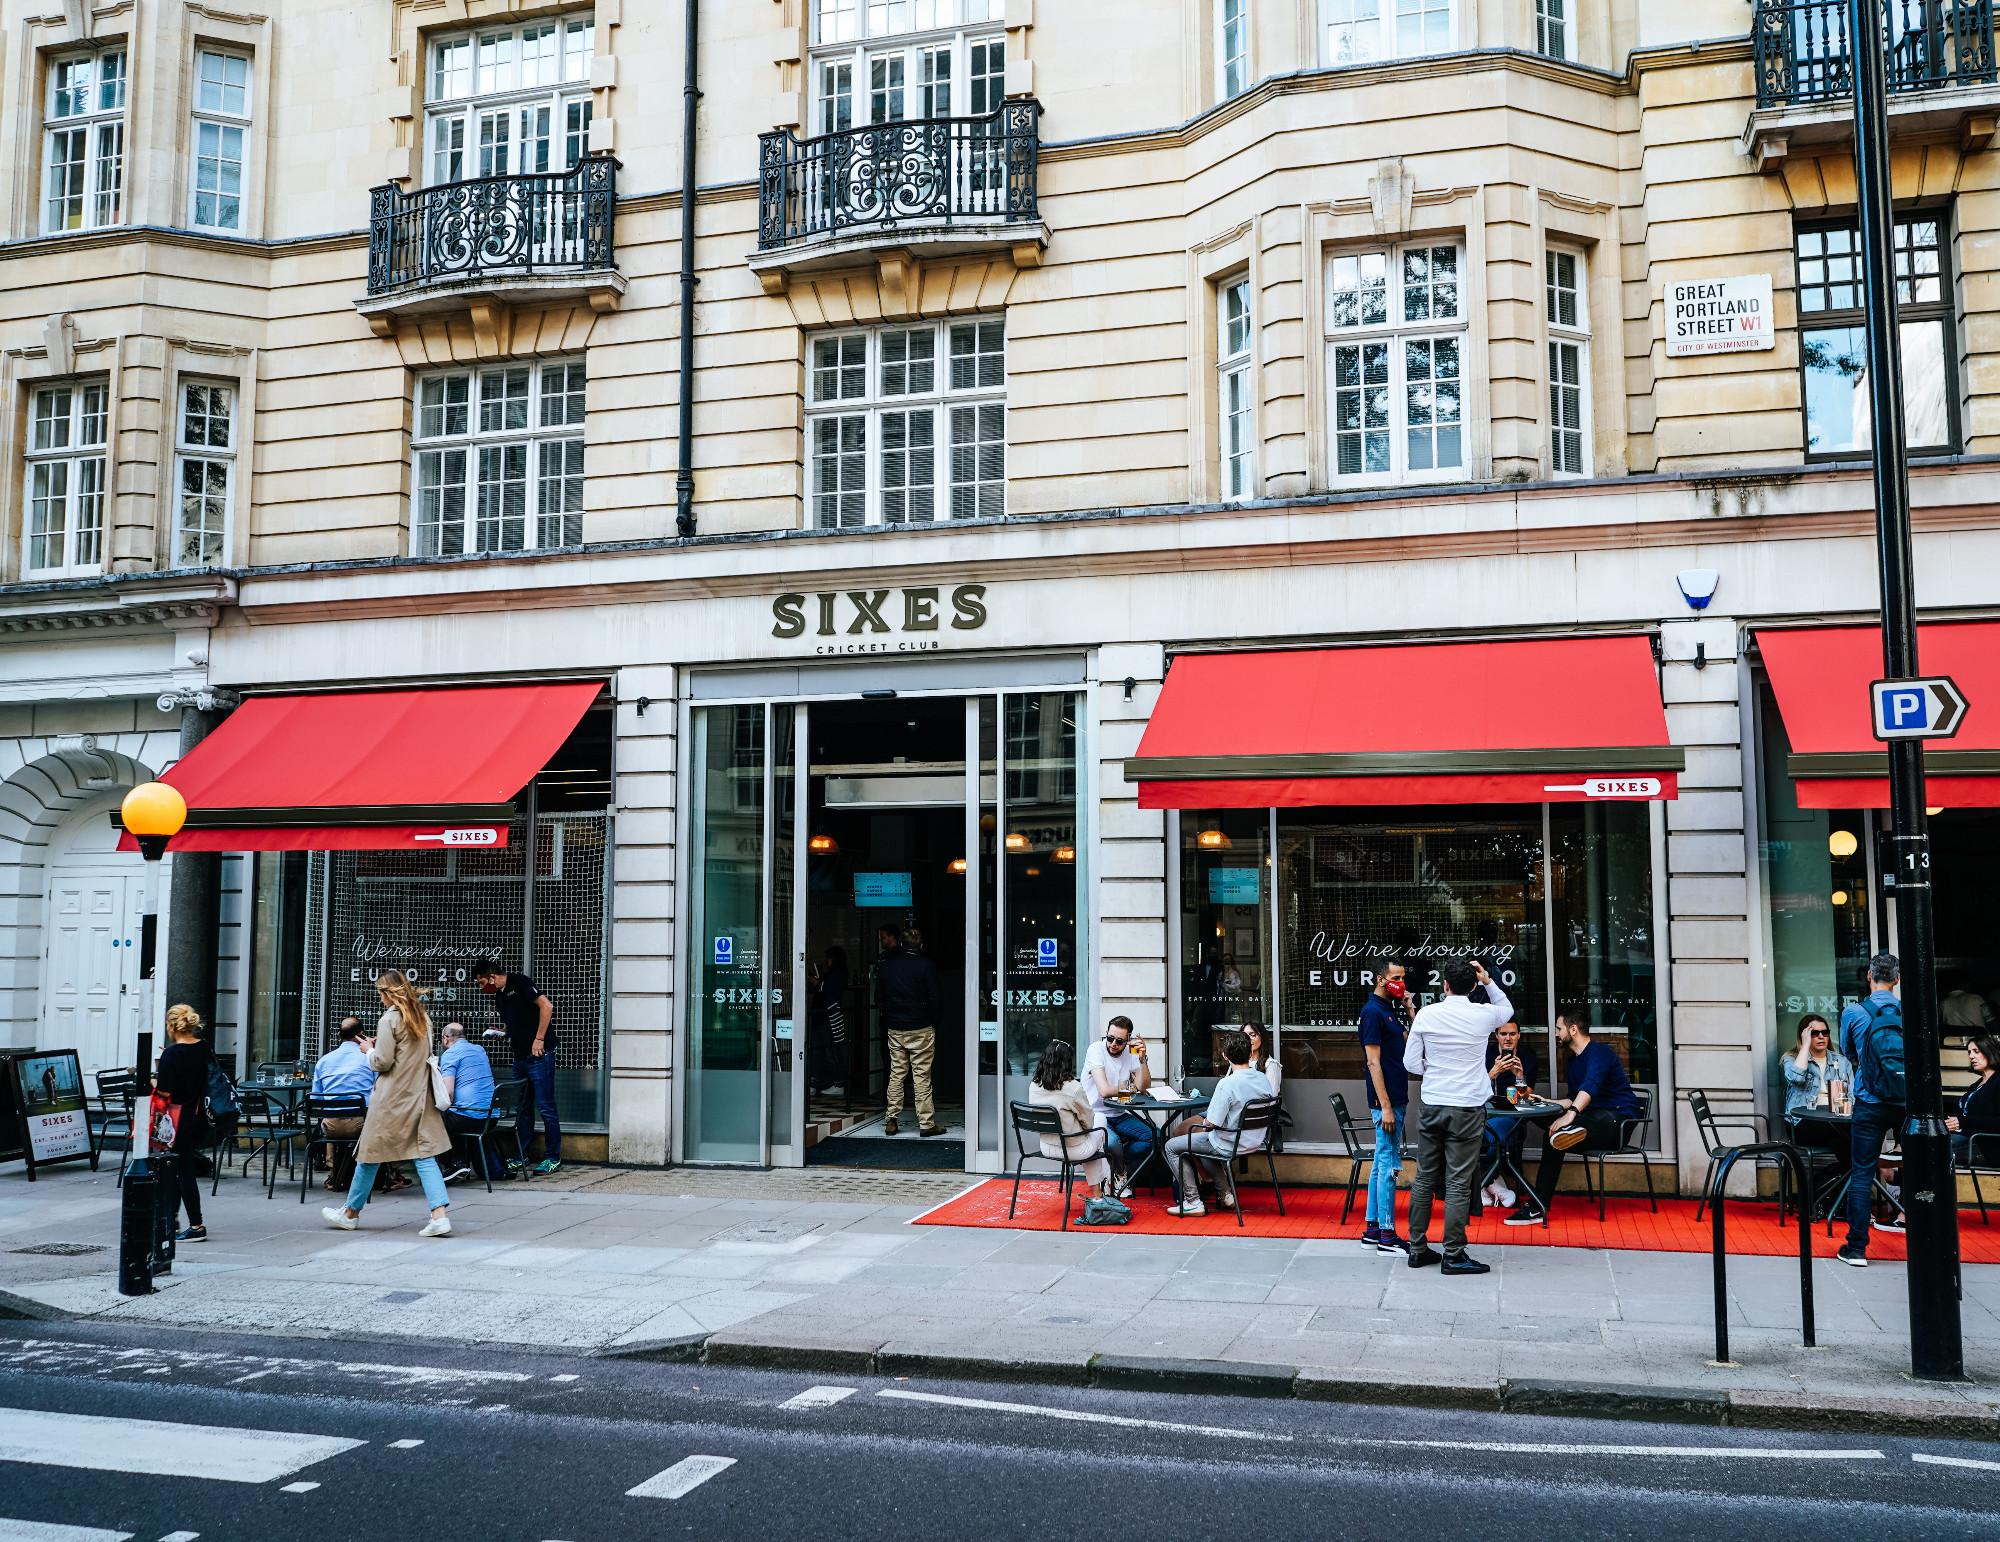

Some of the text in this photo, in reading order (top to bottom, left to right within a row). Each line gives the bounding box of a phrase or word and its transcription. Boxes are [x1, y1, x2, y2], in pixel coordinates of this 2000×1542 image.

[1675, 283, 1726, 301] GREAT
[1676, 298, 1760, 319] PORTLAND
[1677, 315, 1761, 336] STREET W1
[1677, 340, 1759, 352] CITY OF WESTMINSTER
[772, 584, 987, 638] SIXES
[816, 641, 939, 654] CRICKET CLUB
[1892, 693, 1920, 726] P
[1597, 782, 1649, 792] SIXES
[452, 832, 489, 841] SIXES
[1905, 853, 1930, 870] 13
[351, 934, 504, 961] We're showing
[1310, 931, 1516, 965] We're showing
[351, 968, 419, 982] EUO
[1428, 970, 1516, 986] 20
[1787, 995, 1859, 1013] SIXE
[41, 1115, 73, 1127] SIXES
